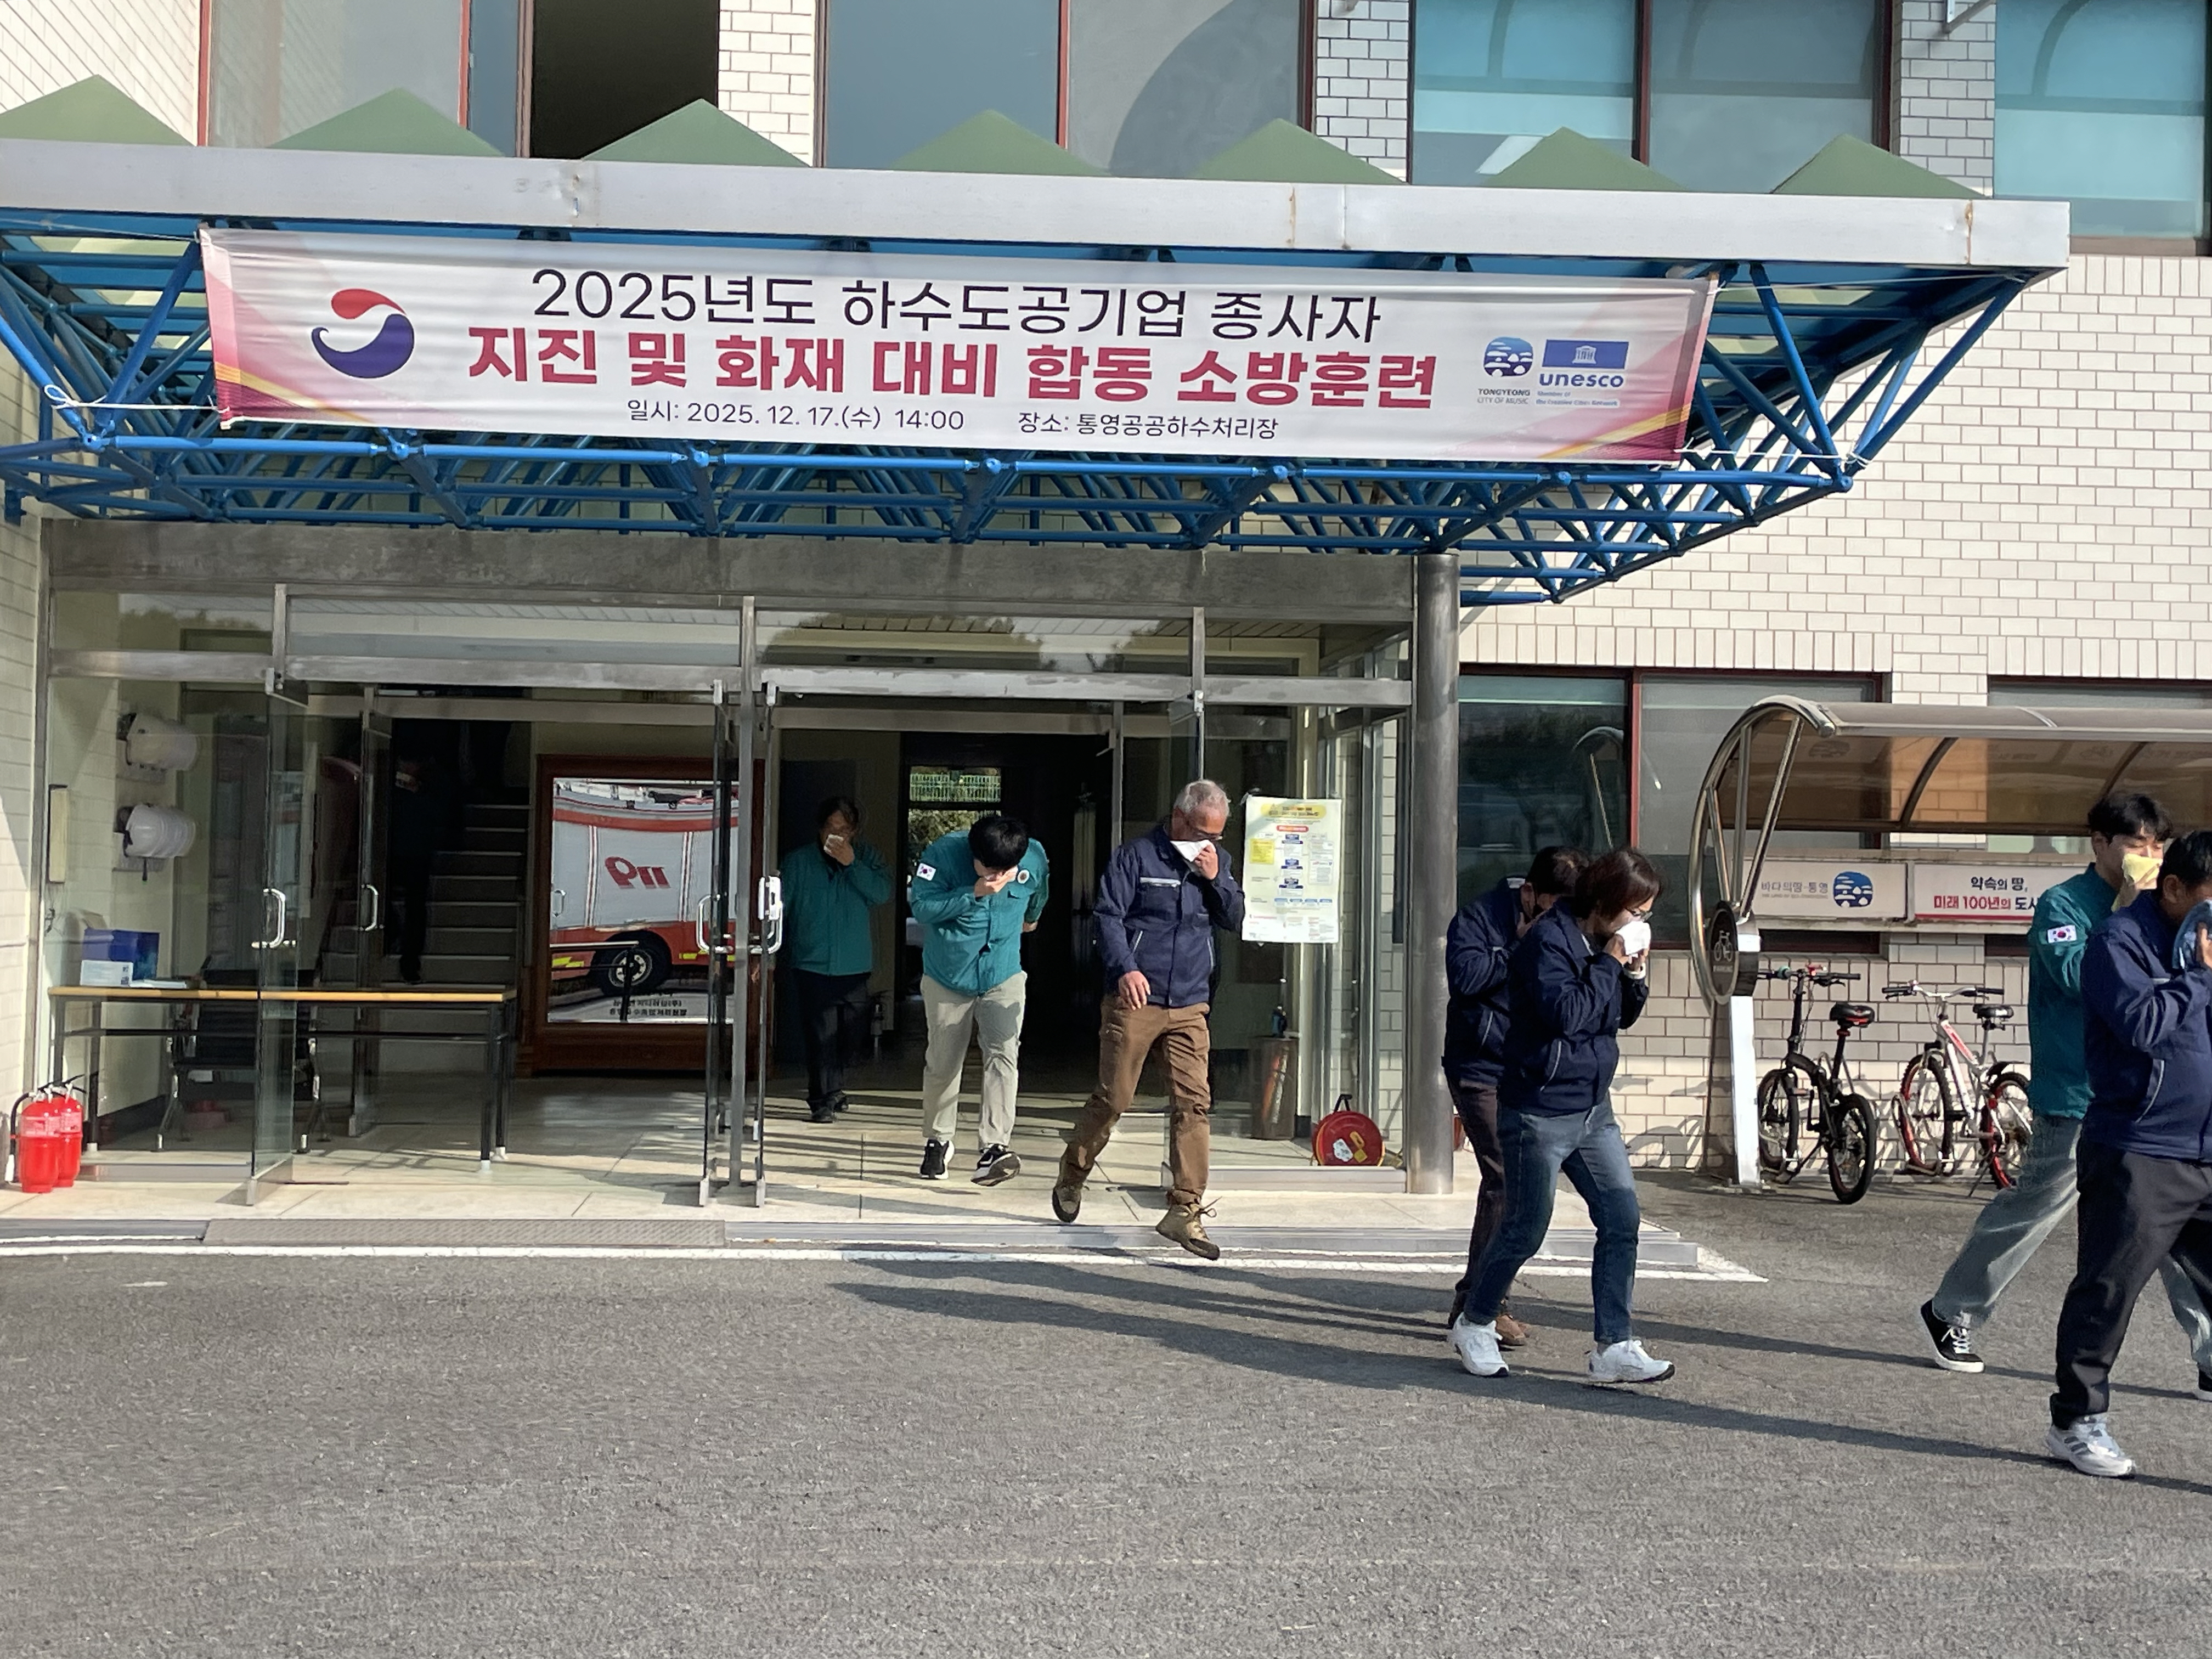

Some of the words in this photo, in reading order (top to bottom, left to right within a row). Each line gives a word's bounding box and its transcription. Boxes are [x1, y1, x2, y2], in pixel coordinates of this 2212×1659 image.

[532, 269, 816, 324] 2025년도
[842, 280, 1184, 338] 하수도공기업
[1211, 292, 1381, 343] 종사자
[469, 326, 598, 385] 지진
[628, 332, 687, 387] 및
[714, 335, 845, 393] 화재
[872, 340, 996, 398] 대비
[1026, 344, 1153, 402] 합동
[1176, 350, 1436, 409] 소방훈련
[1539, 373, 1624, 387] unesco
[627, 399, 679, 422] 일시:
[687, 403, 760, 424] 2025.
[768, 405, 800, 425] 12.
[894, 409, 964, 430] 14:00
[1018, 412, 1069, 433] 장소:
[1076, 414, 1279, 439] 통영공공하수처리장
[1971, 877, 2008, 890] 약속의
[1934, 896, 1959, 909] 미래
[1962, 896, 2011, 910] 100년의
